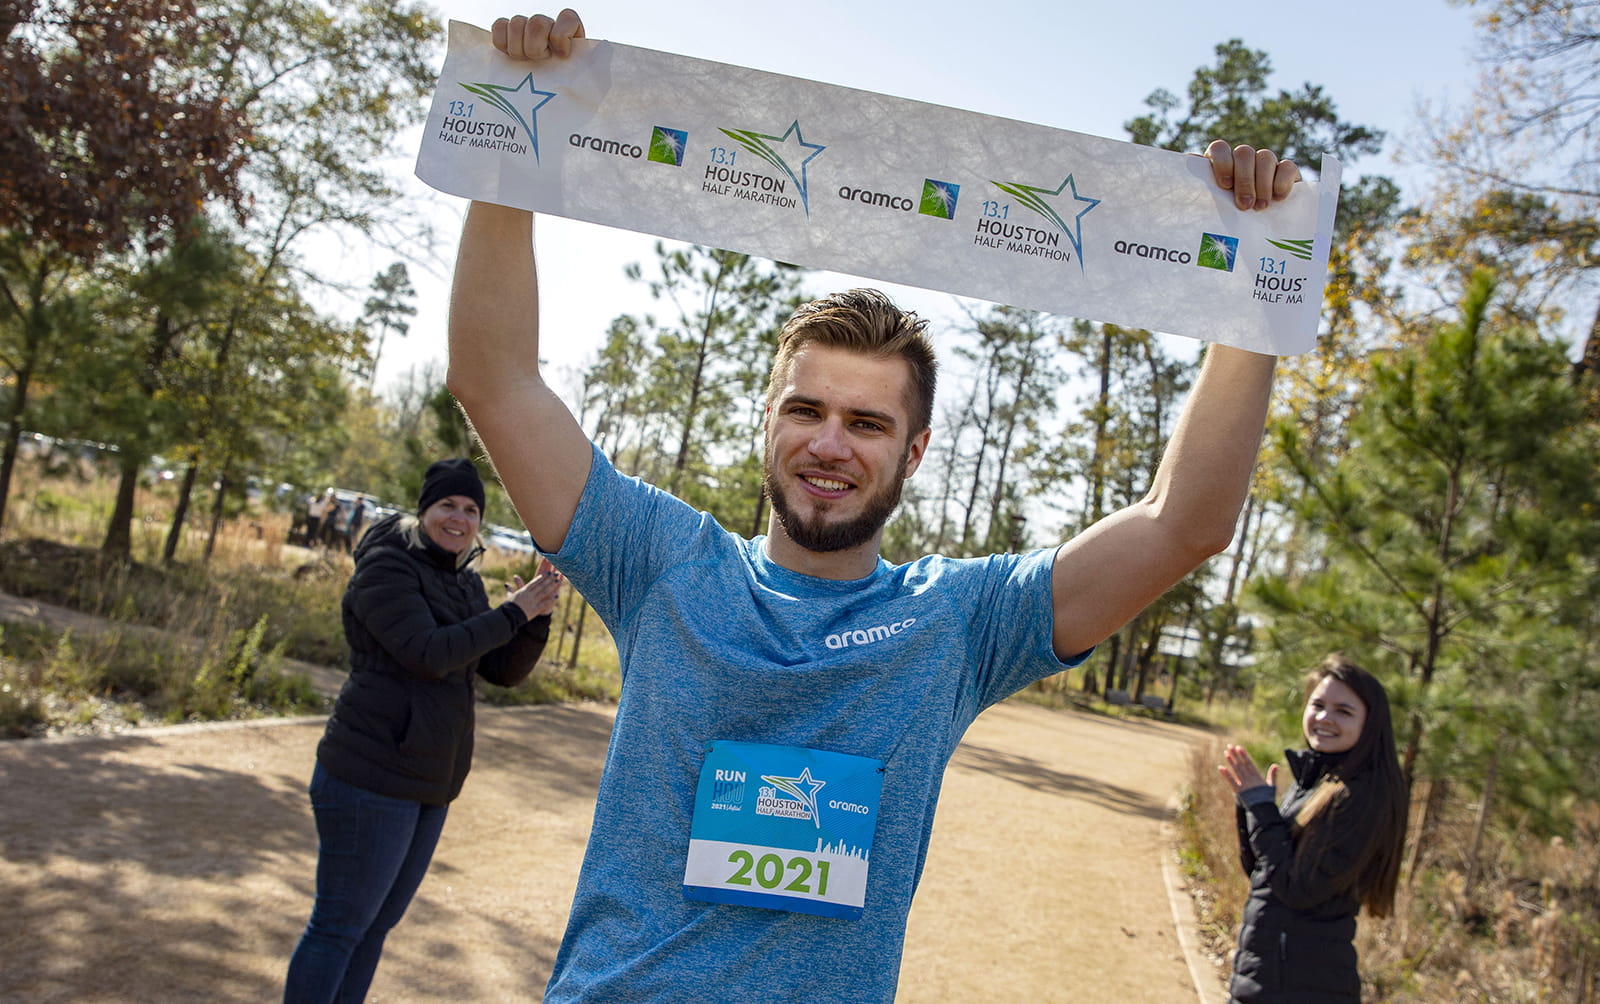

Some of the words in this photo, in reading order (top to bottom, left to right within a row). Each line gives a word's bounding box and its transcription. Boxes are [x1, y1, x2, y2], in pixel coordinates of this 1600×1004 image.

[449, 100, 474, 118] 13.1
[442, 117, 517, 140] HOUSTON
[438, 130, 467, 146] HALF
[469, 137, 527, 155] MARATHON
[569, 133, 643, 159] aramco
[710, 147, 737, 166] 13.1
[704, 165, 786, 194] HOUSTON
[702, 181, 732, 196] HALF
[734, 188, 797, 209] MARATHON
[838, 186, 913, 212] aramco
[982, 200, 1010, 219] 13.1
[976, 218, 1060, 247] HOUSTON
[974, 235, 1005, 249] HALF
[1006, 241, 1071, 263] MARATHON
[1114, 240, 1192, 264] aramco
[1259, 256, 1286, 275] 13.1
[1255, 273, 1307, 292] HOUS
[1252, 289, 1283, 304] HALF
[825, 618, 917, 649] aramco
[715, 769, 746, 783] RUN
[756, 807, 773, 815] HALF
[774, 809, 811, 819] MARATHON
[758, 797, 804, 811] HOUSTON
[828, 800, 869, 815] aramco
[725, 850, 831, 896] 2021
